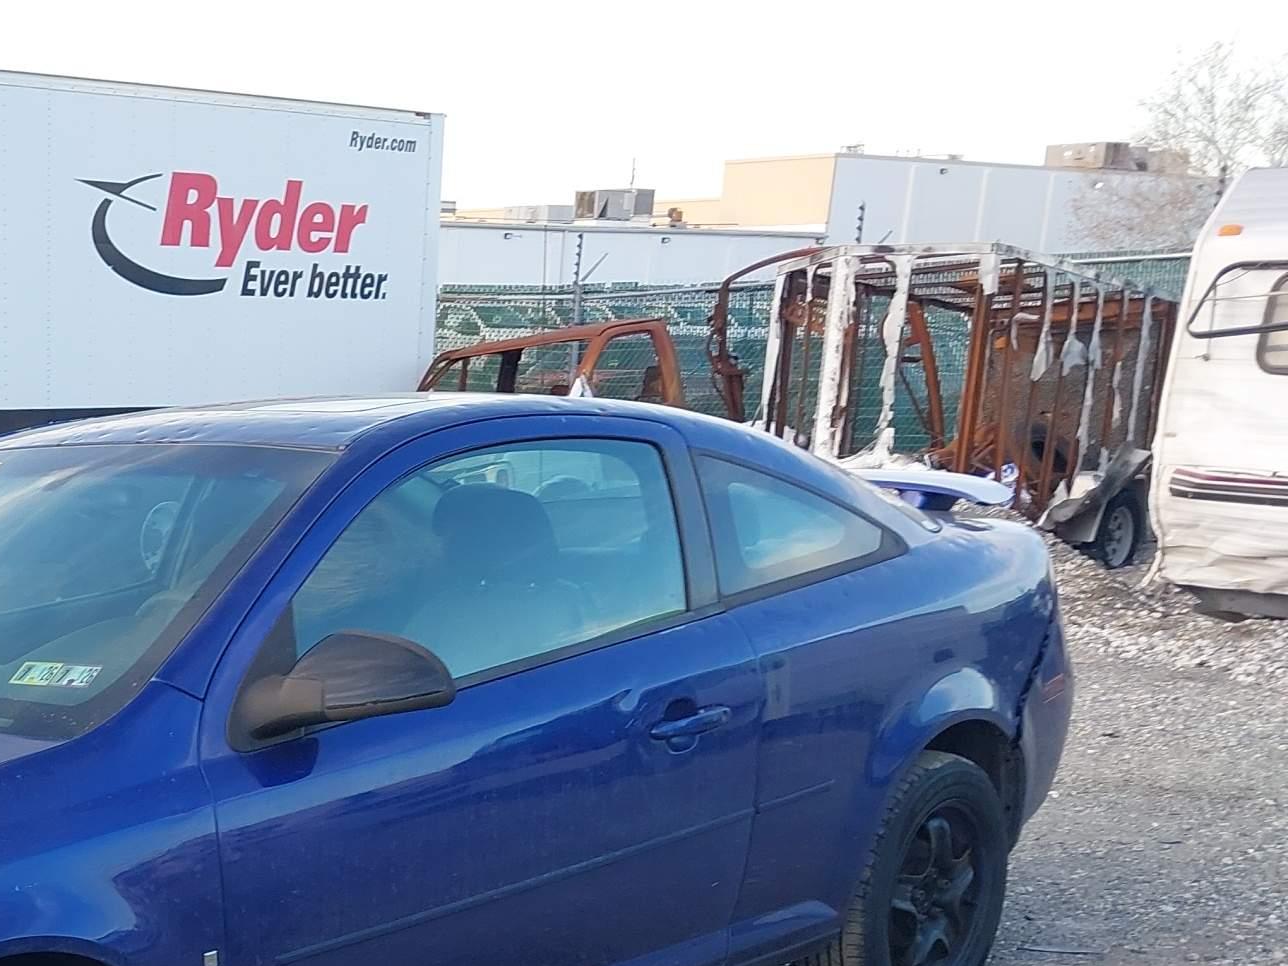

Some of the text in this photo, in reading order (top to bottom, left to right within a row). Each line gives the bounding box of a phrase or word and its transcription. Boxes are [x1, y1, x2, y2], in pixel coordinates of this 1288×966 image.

[349, 130, 417, 153] Ryder.com
[160, 171, 369, 268] Ryder
[240, 260, 388, 300] Ever better.
